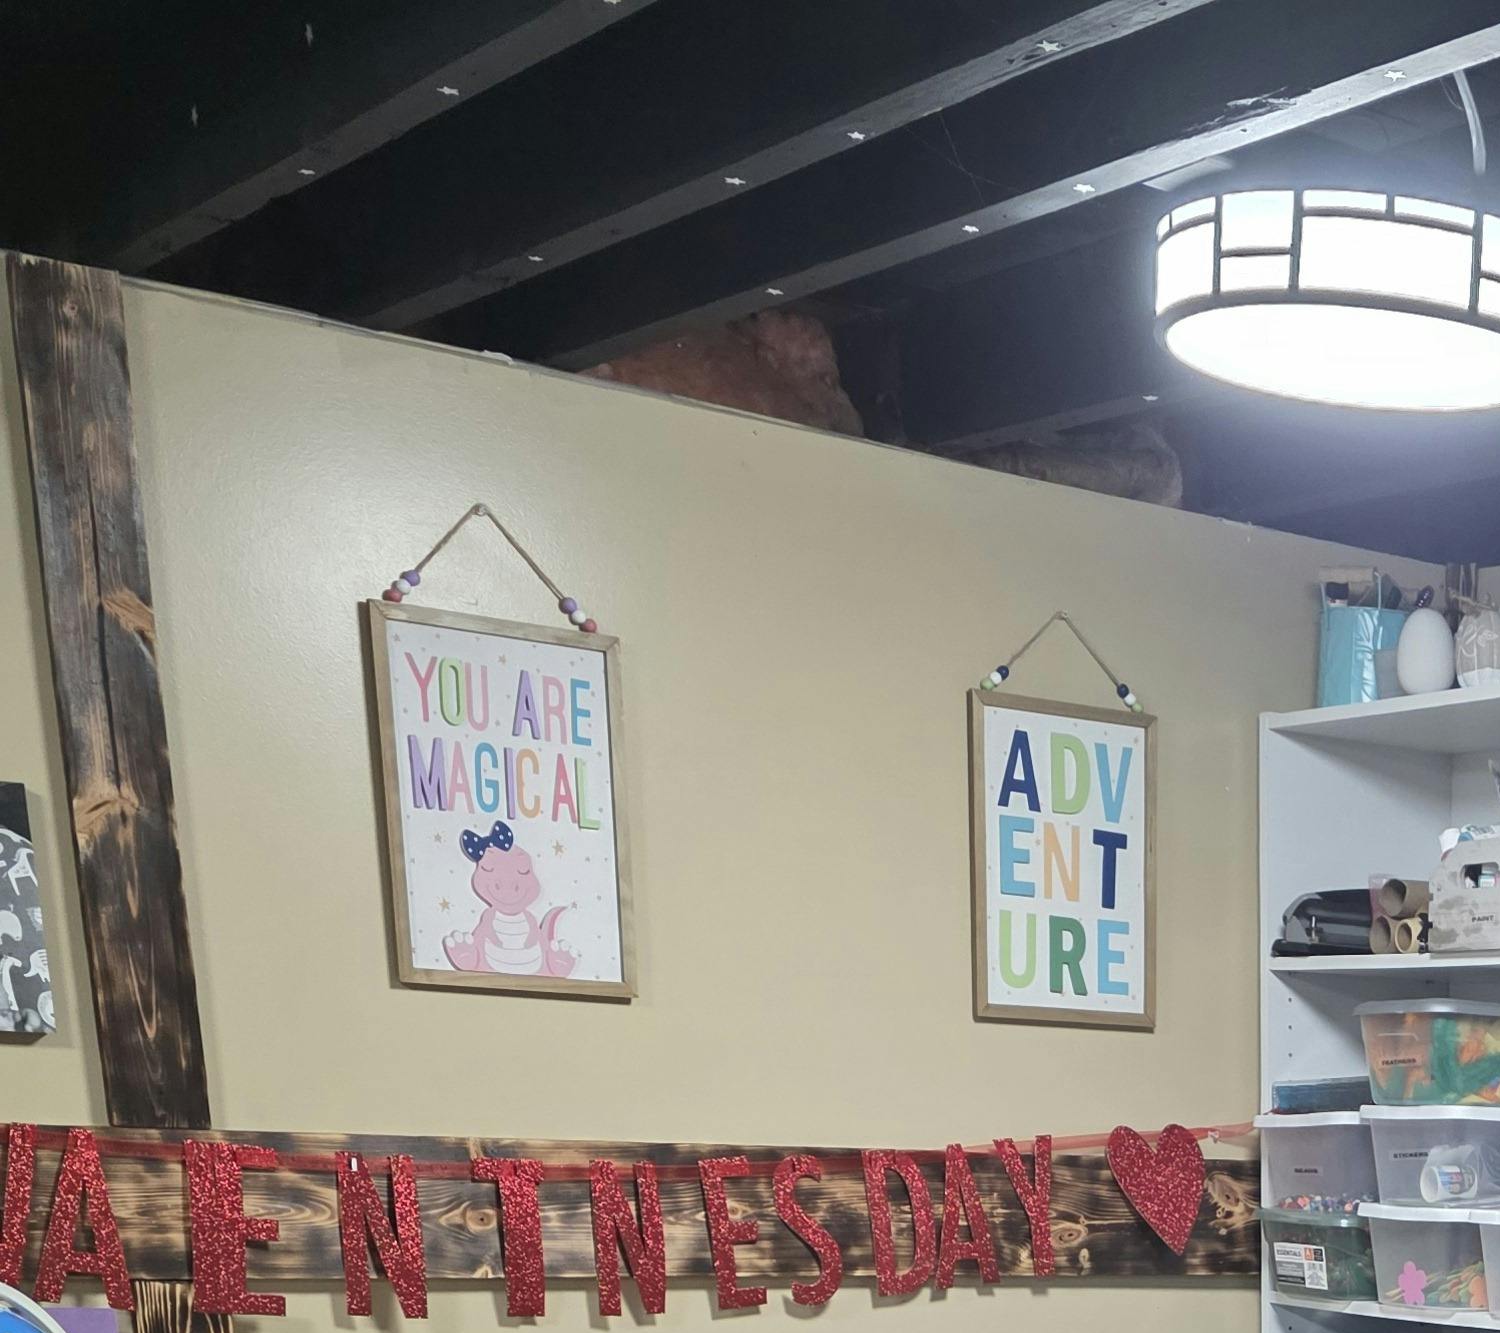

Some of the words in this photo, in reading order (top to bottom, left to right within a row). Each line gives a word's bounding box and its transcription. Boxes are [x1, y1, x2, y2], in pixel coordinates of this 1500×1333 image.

[404, 651, 490, 732] YOU
[511, 669, 593, 747] ARE
[407, 734, 601, 831] MAGICAL
[997, 729, 1134, 825] ADV
[998, 814, 1128, 911] ENT
[998, 908, 1130, 997] URE
